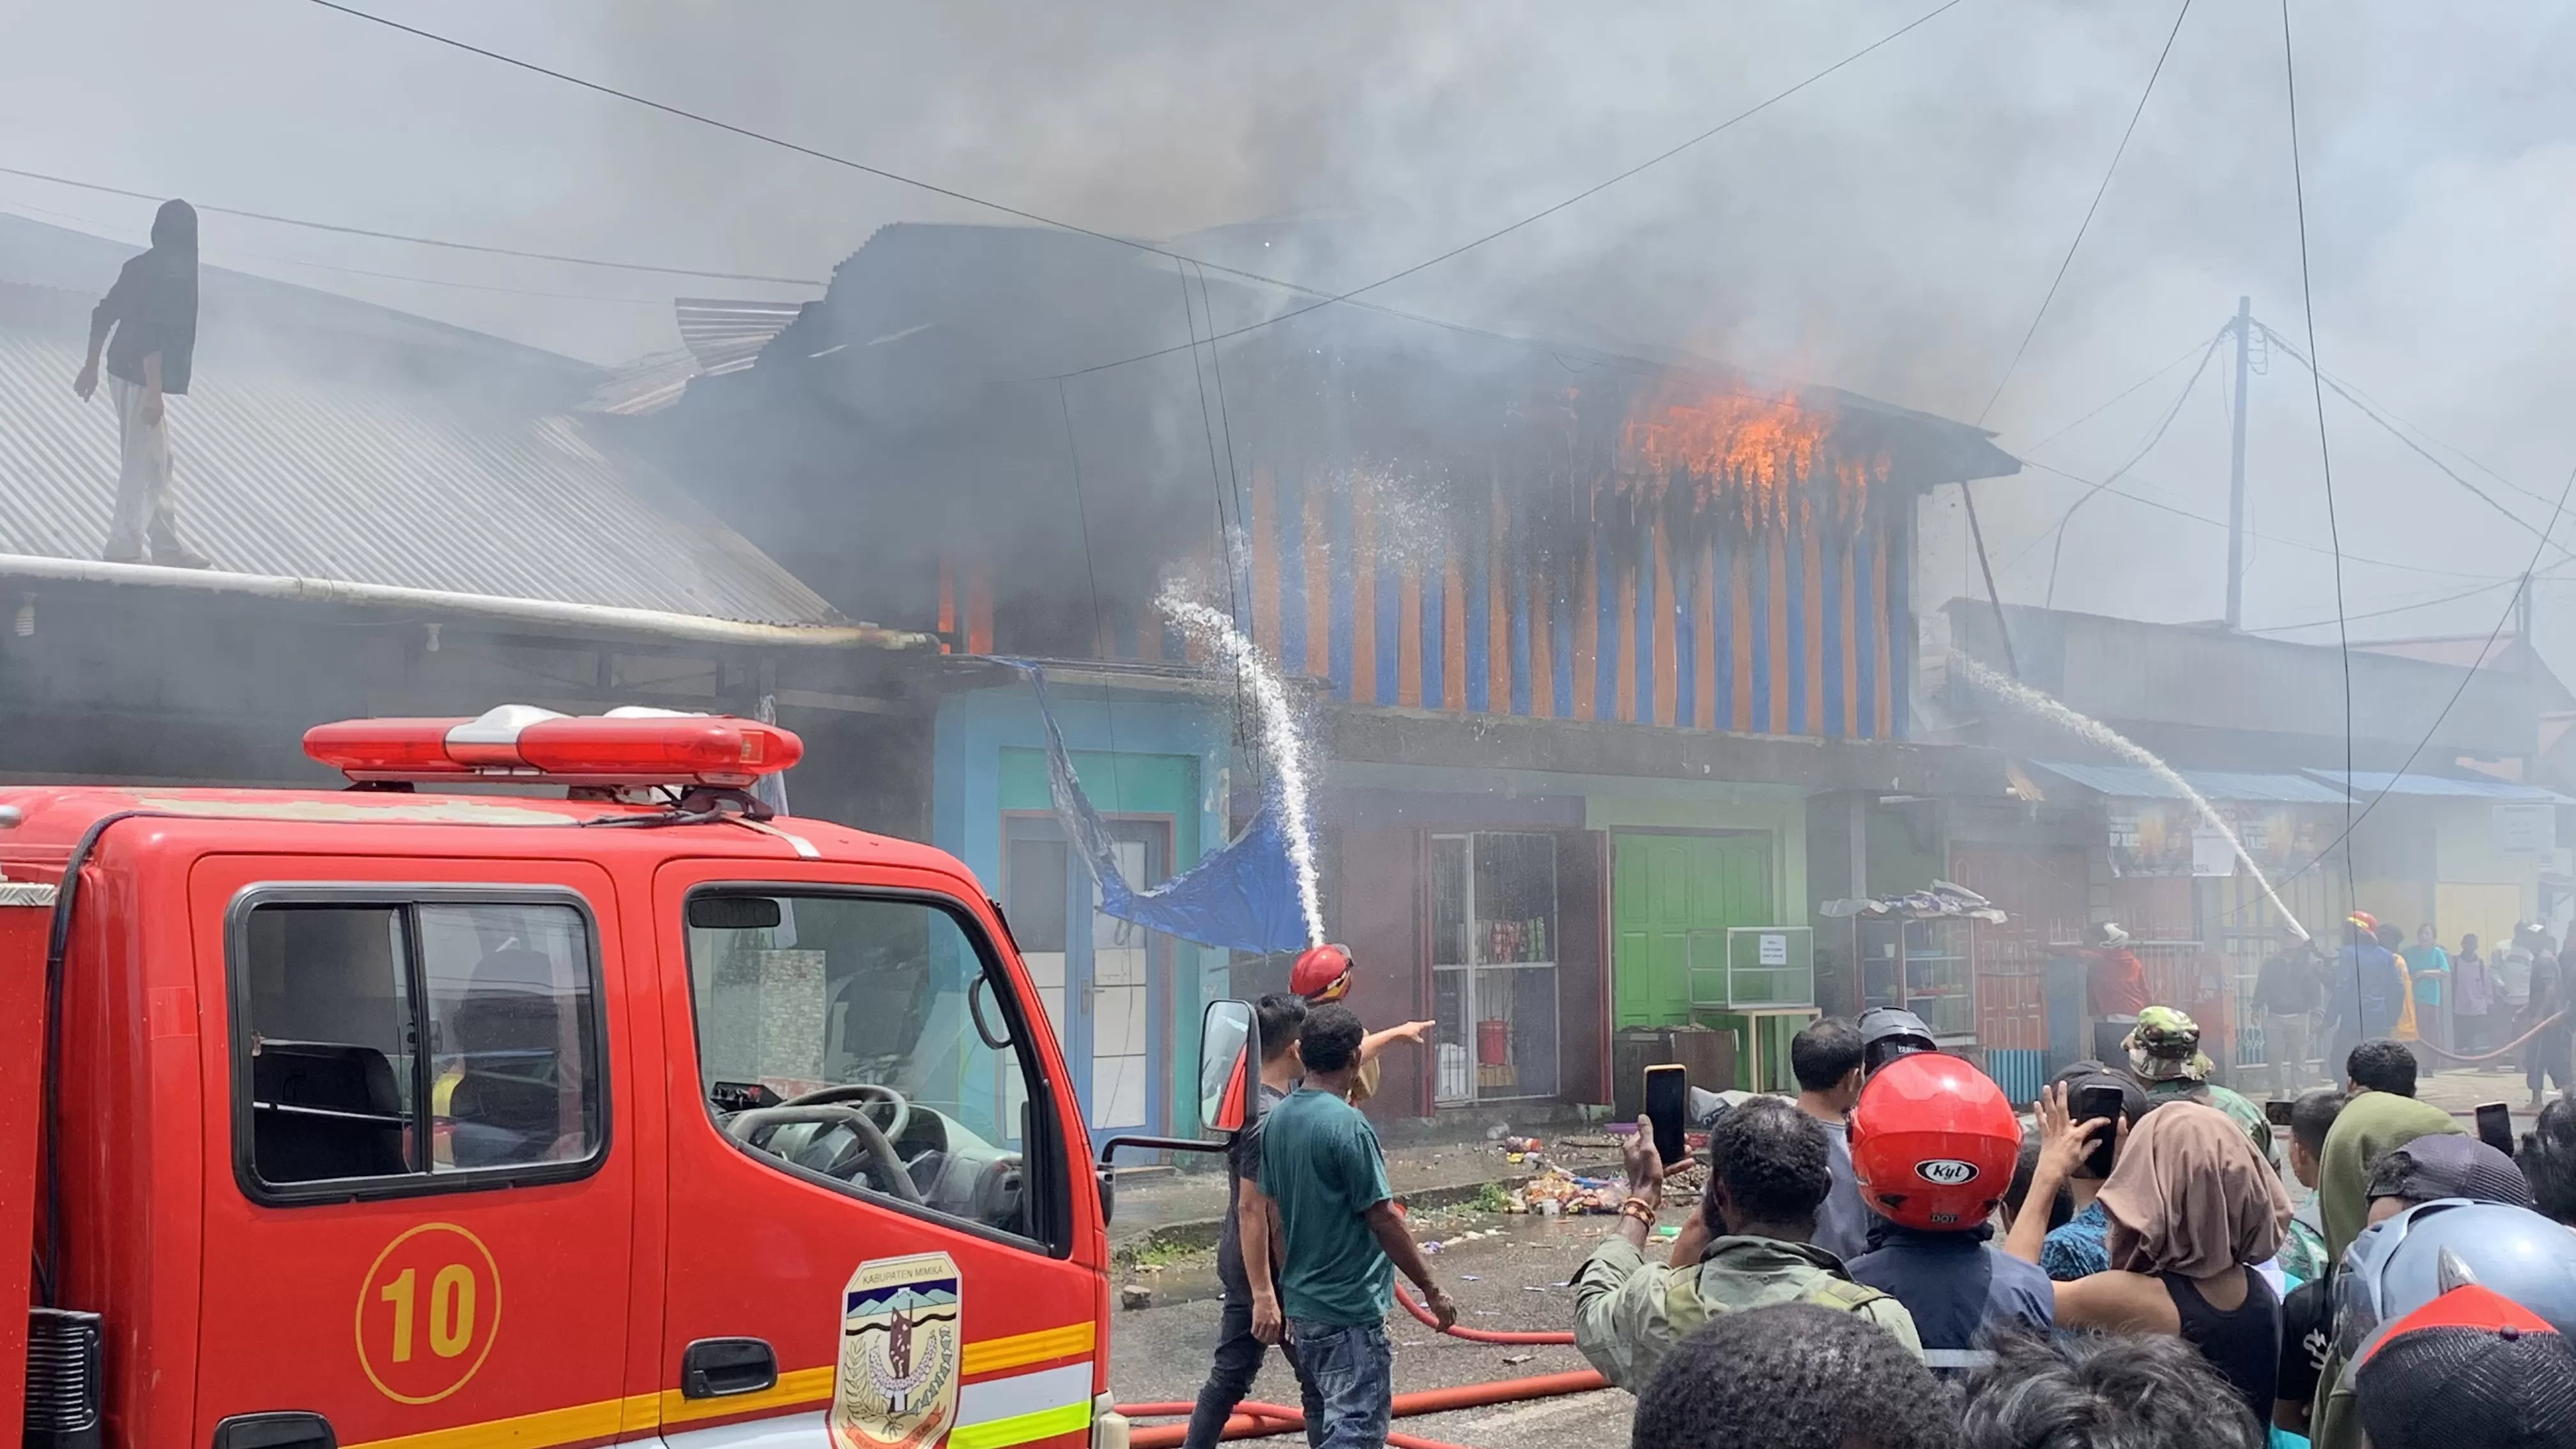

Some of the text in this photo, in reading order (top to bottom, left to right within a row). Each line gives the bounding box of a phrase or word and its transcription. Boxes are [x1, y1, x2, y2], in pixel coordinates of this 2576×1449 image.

[1931, 1213, 1957, 1223] DOT
[863, 1265, 943, 1284] KABUPATEN MIMIKA
[381, 1263, 476, 1363] 10
